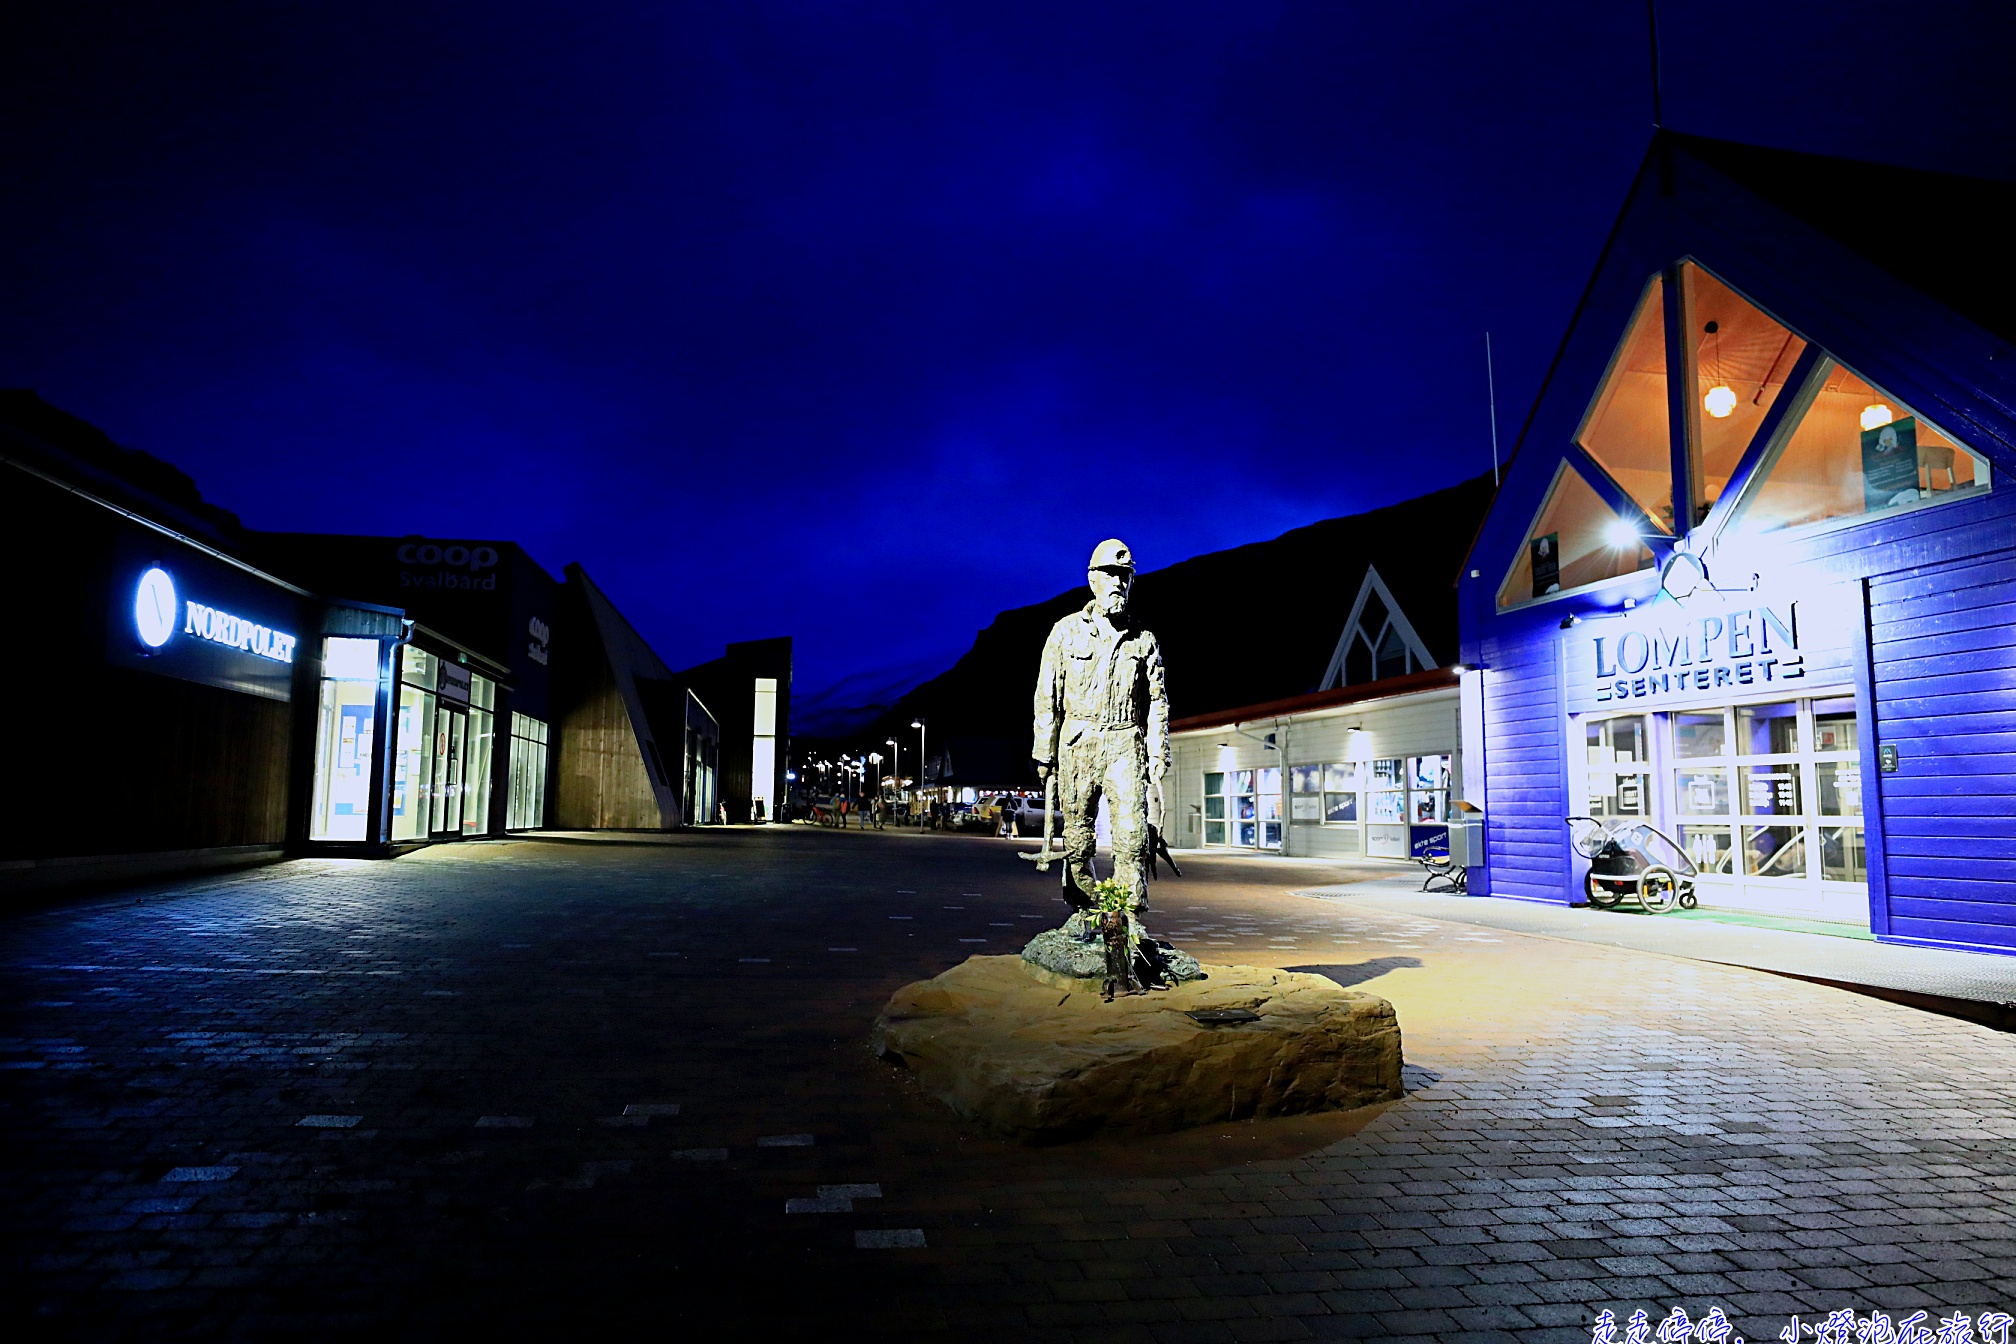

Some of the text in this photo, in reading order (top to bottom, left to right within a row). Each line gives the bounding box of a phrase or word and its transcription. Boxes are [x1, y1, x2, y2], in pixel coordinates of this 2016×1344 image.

[397, 543, 499, 572] coop
[400, 571, 496, 591] Svalbard
[184, 600, 296, 664] NORDPOLET
[1593, 601, 1799, 678] LOMPEN
[1614, 658, 1779, 699] SENTERET
[1429, 832, 1447, 844] sport
